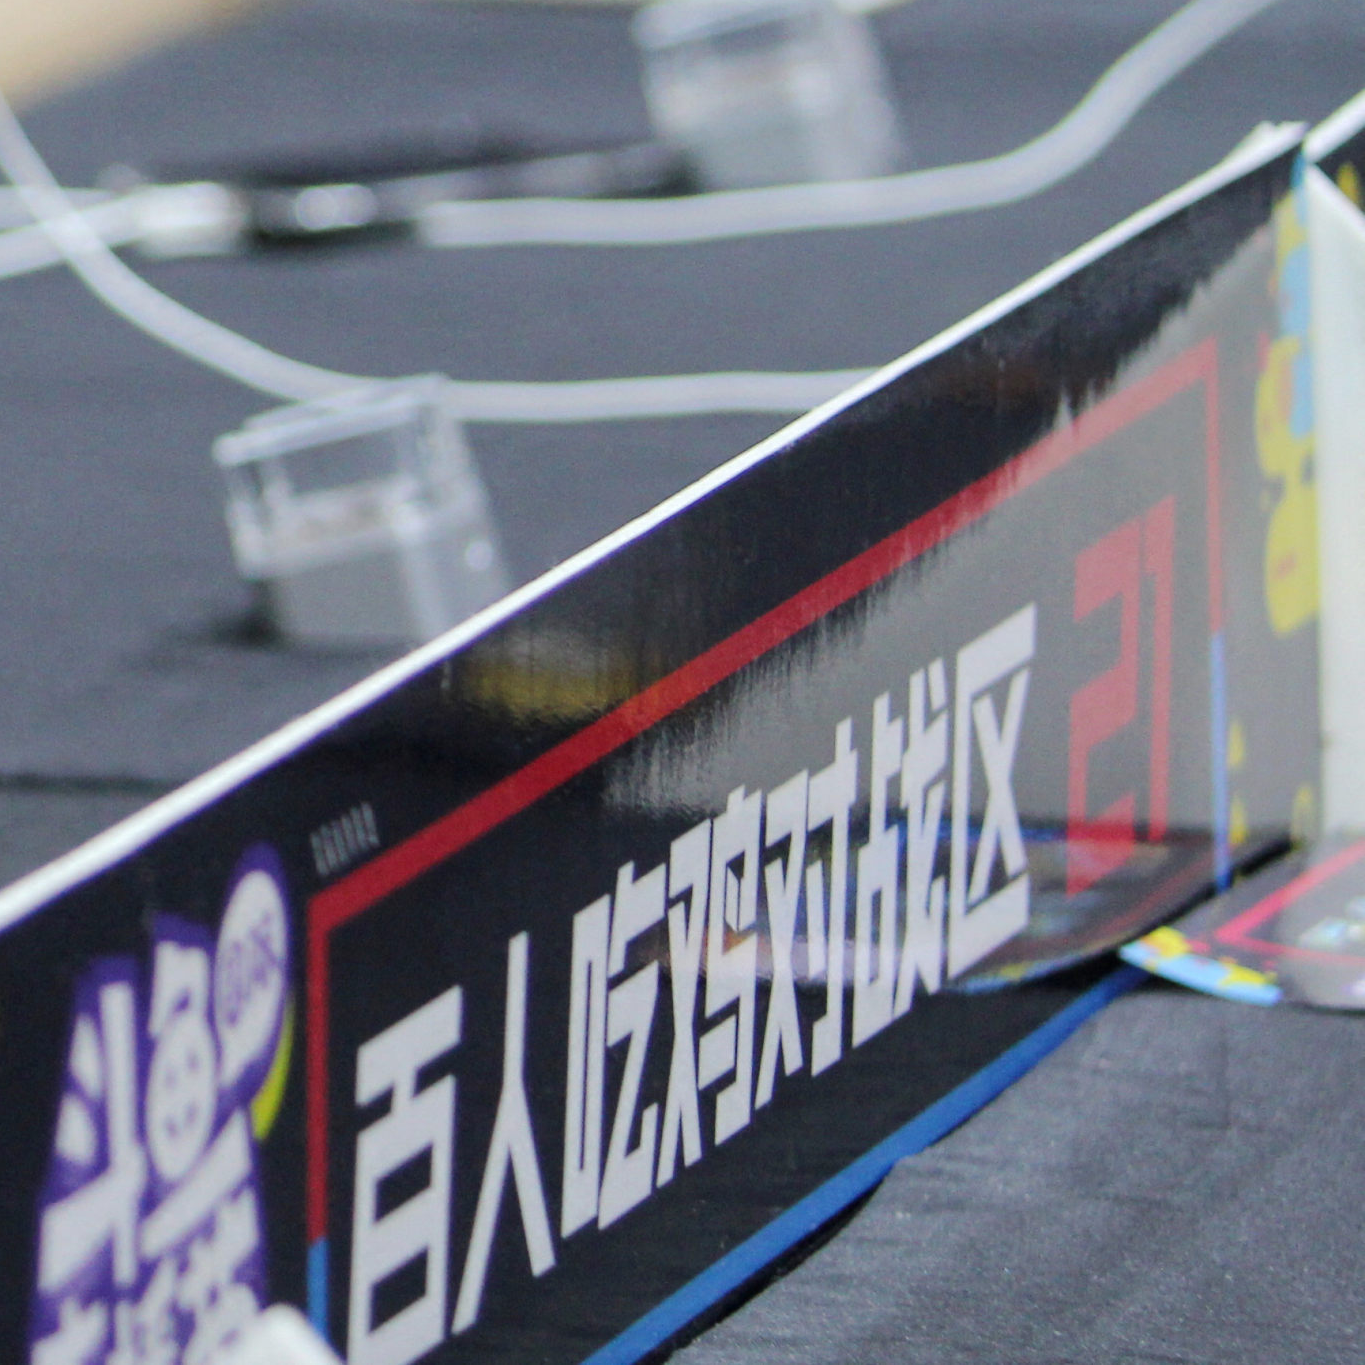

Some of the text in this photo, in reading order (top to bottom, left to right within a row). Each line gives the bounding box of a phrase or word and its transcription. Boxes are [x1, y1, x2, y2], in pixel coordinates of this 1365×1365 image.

[346, 601, 1037, 1365] 百人吃鸡对战区
